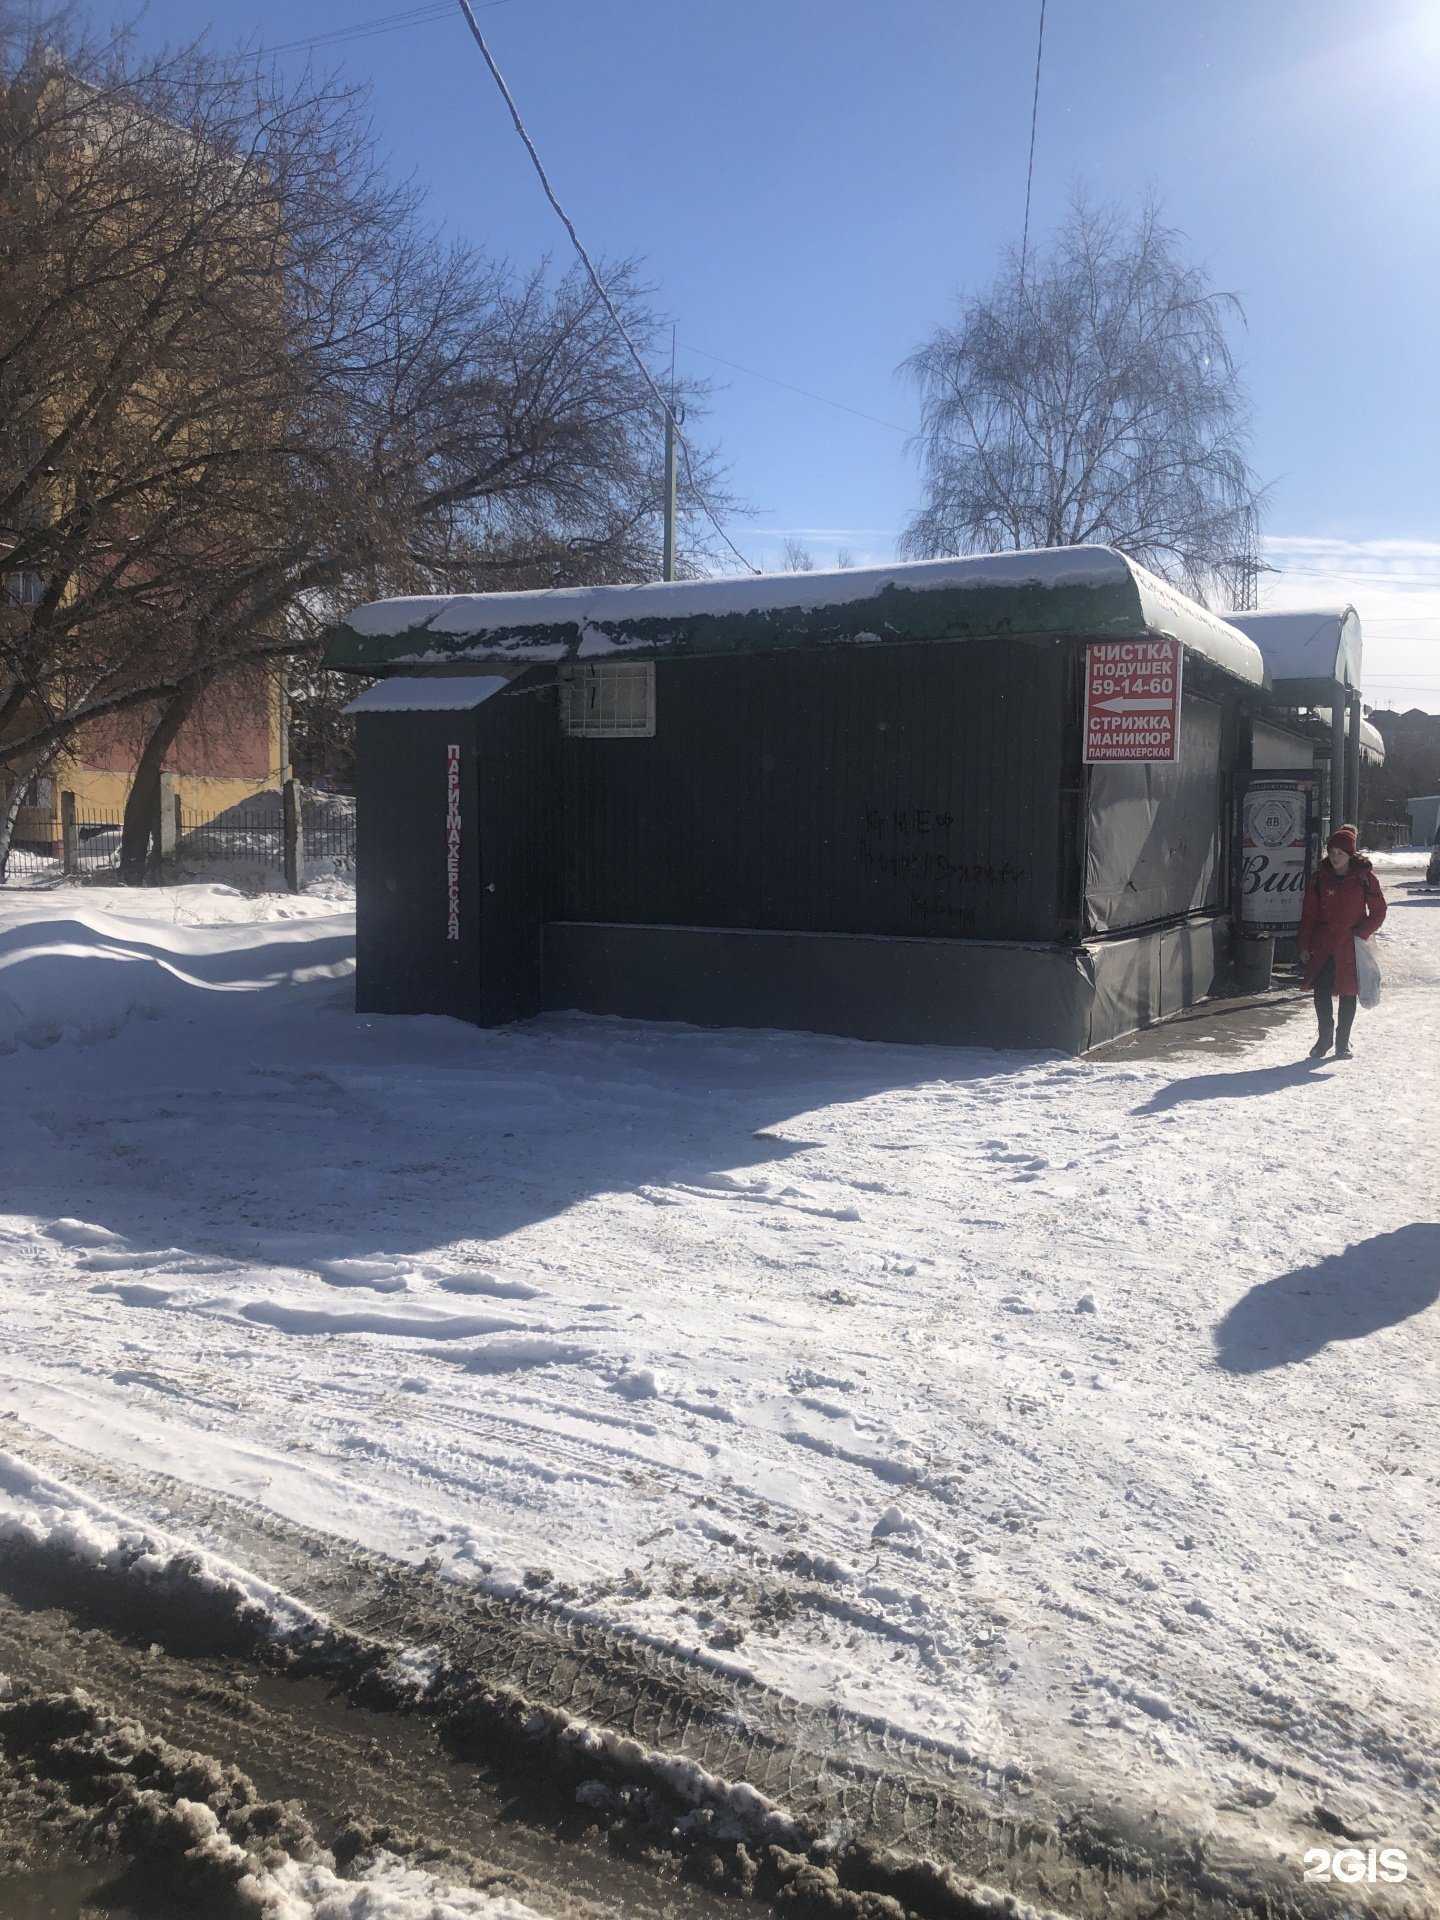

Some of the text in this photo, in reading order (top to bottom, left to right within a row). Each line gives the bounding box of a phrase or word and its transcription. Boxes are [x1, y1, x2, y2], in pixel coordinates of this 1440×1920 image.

[1093, 643, 1174, 660] ЧИСТКА
[1093, 661, 1172, 678] ПОДУШЕК
[1092, 678, 1173, 695] 59-14-60
[1090, 715, 1171, 730] СТРИЖКА
[1088, 732, 1171, 746] МАНИКЮР
[1088, 747, 1171, 758] ПАРИКМАХЕРСКАЯ
[447, 744, 461, 940] ПАРИКМАХЕРСКАЯ
